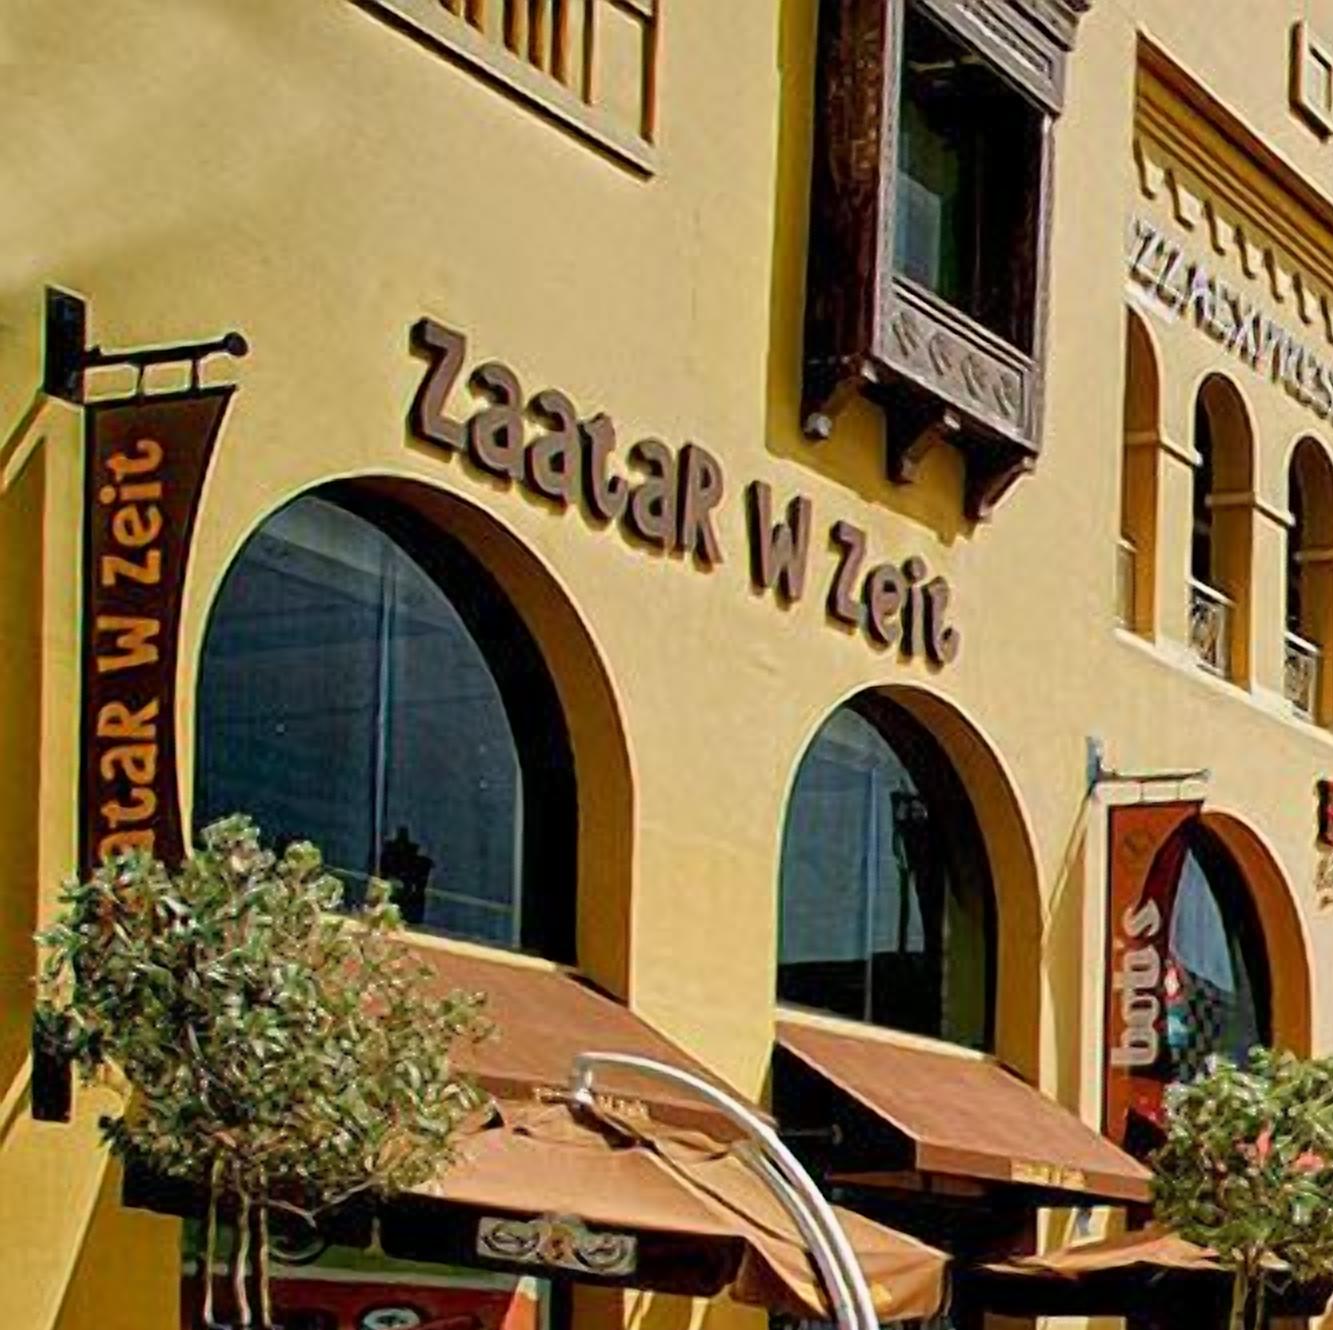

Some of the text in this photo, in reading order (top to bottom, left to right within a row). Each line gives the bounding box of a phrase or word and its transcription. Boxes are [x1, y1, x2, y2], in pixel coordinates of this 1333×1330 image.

[100, 438, 164, 586] Zeit
[745, 478, 812, 610] W
[824, 518, 961, 674] Zeit
[96, 614, 161, 673] W
